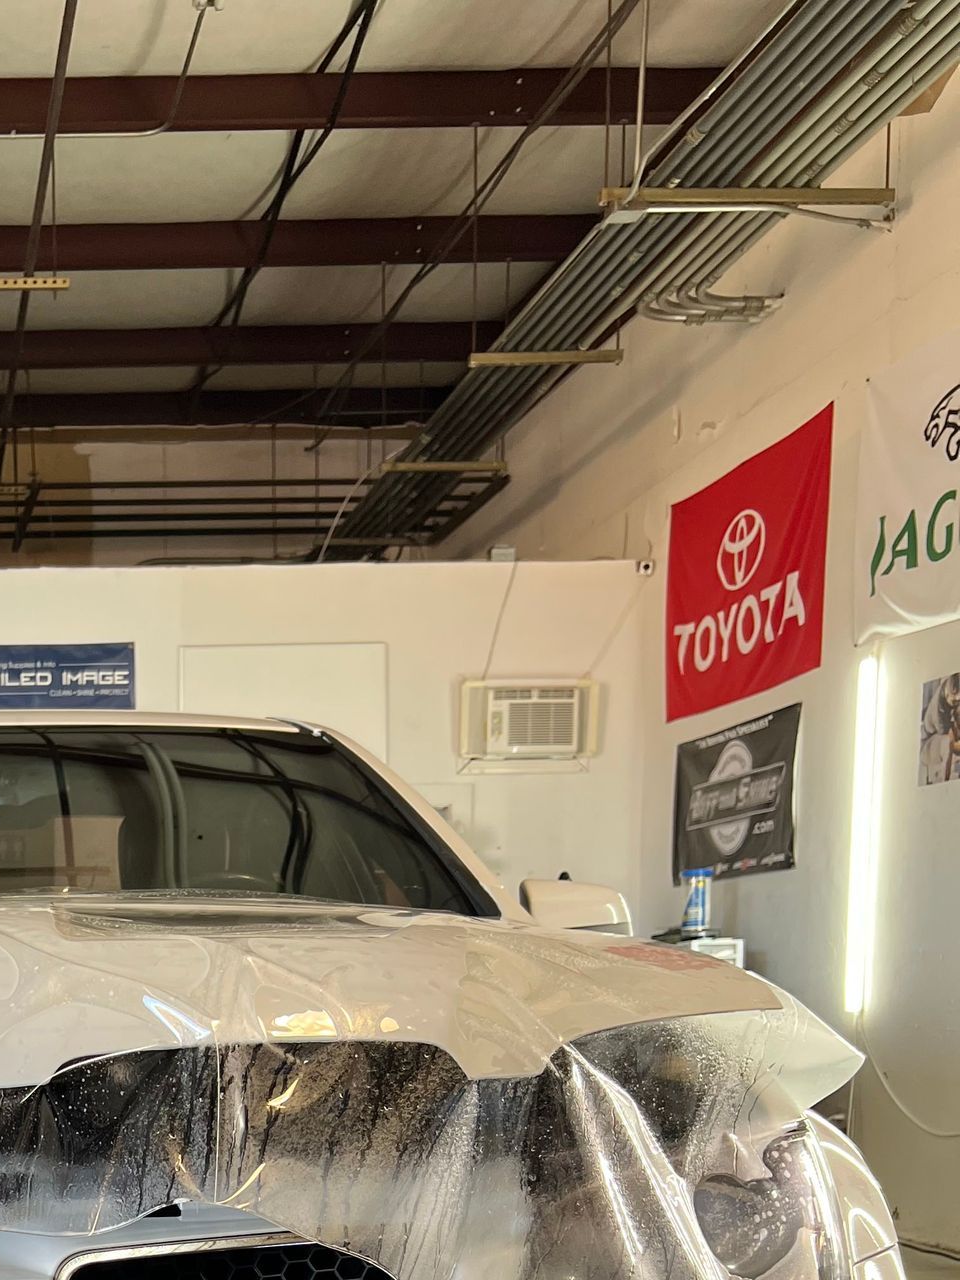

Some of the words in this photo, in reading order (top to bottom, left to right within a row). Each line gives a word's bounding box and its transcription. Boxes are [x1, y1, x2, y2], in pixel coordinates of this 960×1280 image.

[869, 488, 960, 598] JAG
[673, 570, 806, 676] TOYOTA
[61, 671, 130, 686] IMAGE
